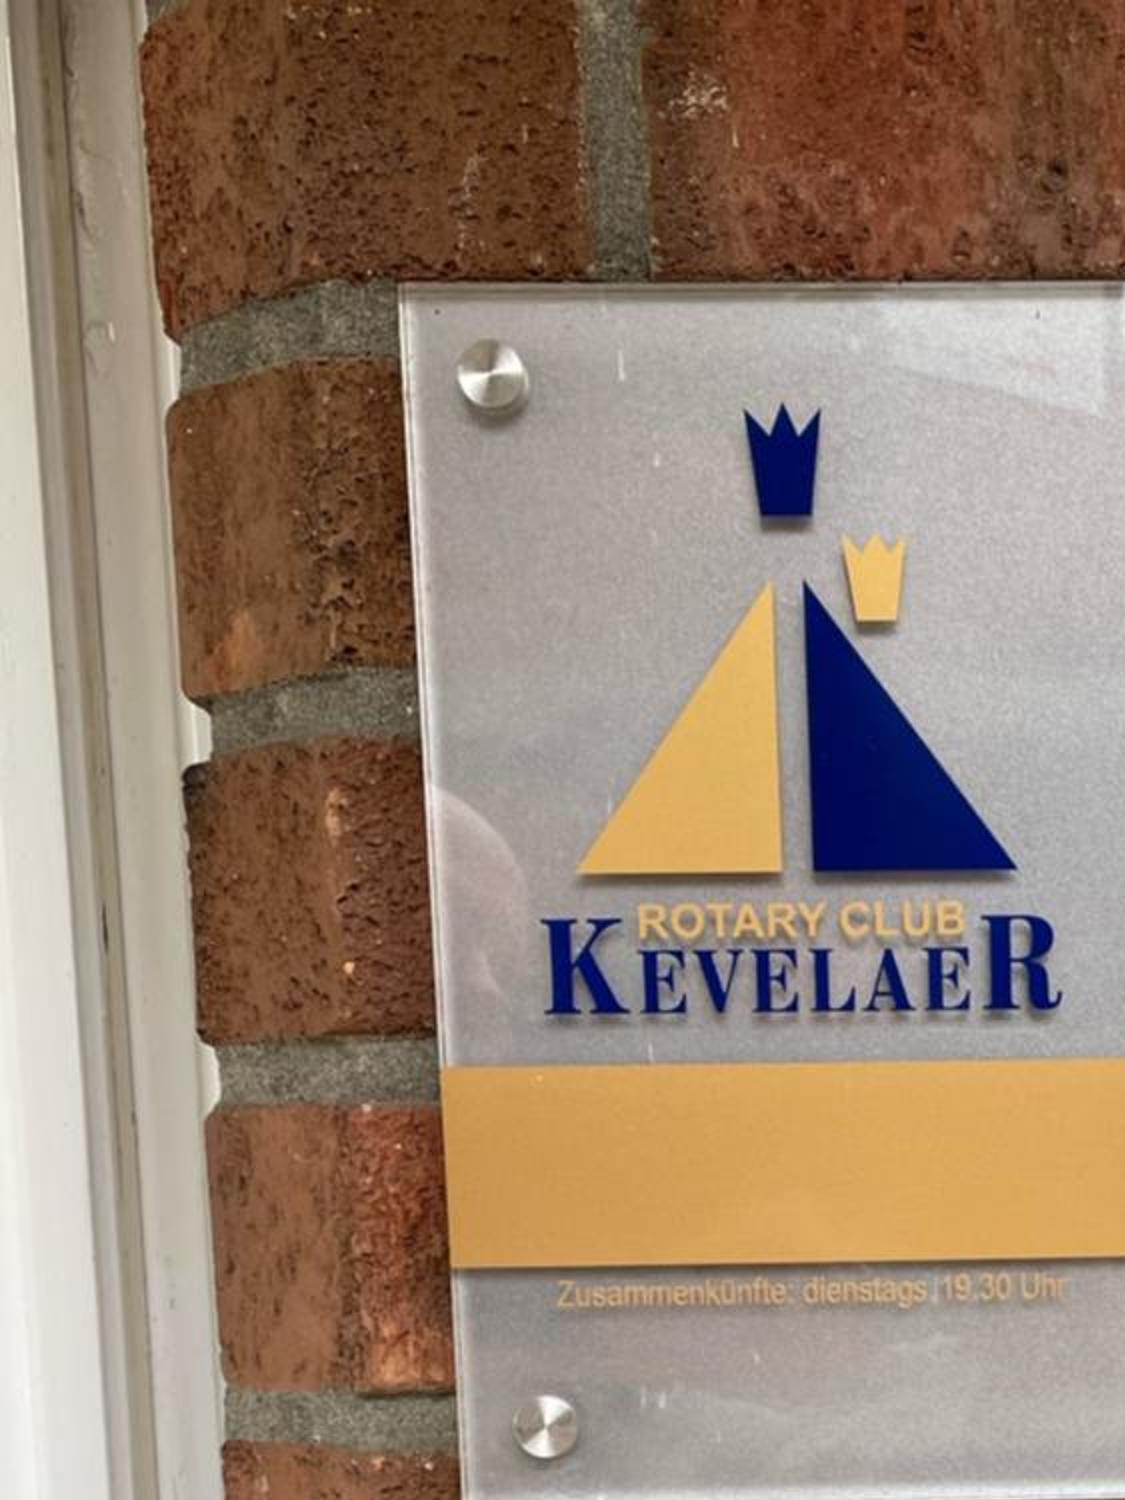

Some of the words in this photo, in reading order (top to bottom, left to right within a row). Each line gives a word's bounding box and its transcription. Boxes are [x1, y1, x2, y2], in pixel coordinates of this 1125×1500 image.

[638, 901, 824, 940] ROTARY
[840, 900, 967, 937] CLUB
[557, 1278, 796, 1309] Zusammenkünfte:
[803, 1275, 929, 1309] dienstags
[1020, 1271, 1069, 1299] Uhr
